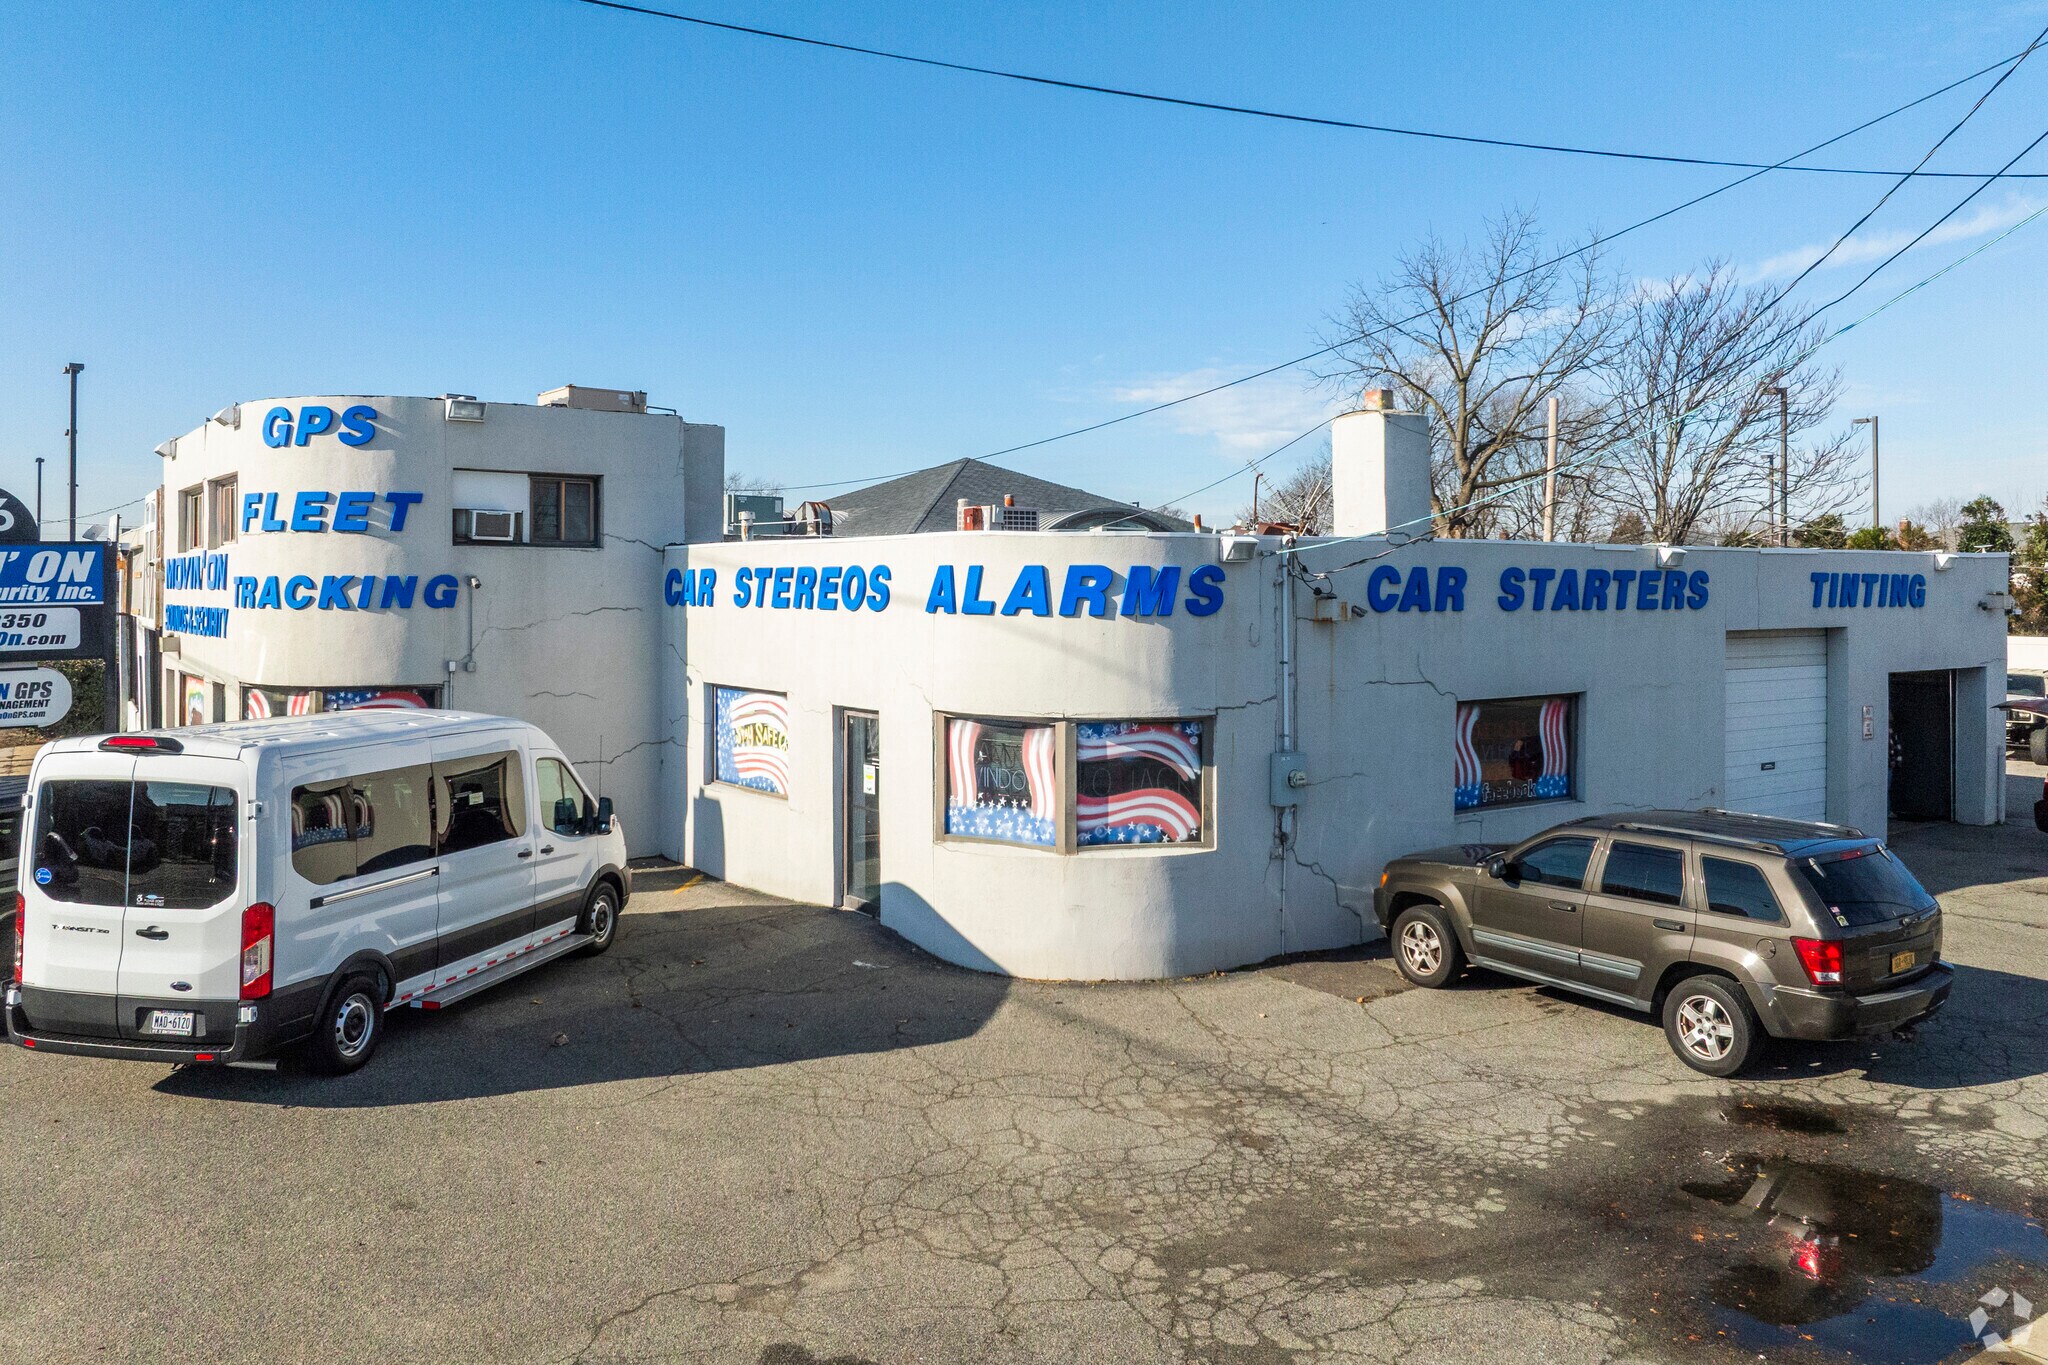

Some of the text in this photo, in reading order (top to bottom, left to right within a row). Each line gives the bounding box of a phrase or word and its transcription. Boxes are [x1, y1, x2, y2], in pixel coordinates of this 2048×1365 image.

[262, 404, 378, 449] GPS
[242, 491, 424, 533] FLEET
[25, 550, 96, 583] ON
[56, 583, 96, 600] Inc.
[233, 573, 460, 611] TRACKING
[665, 564, 892, 613] CAR STEREOS
[926, 563, 1226, 618] ALARMS
[1367, 564, 1711, 613] CAR STARTERS
[1810, 572, 1927, 608] TINTING
[0, 613, 48, 629] 350
[14, 680, 54, 700] GPS
